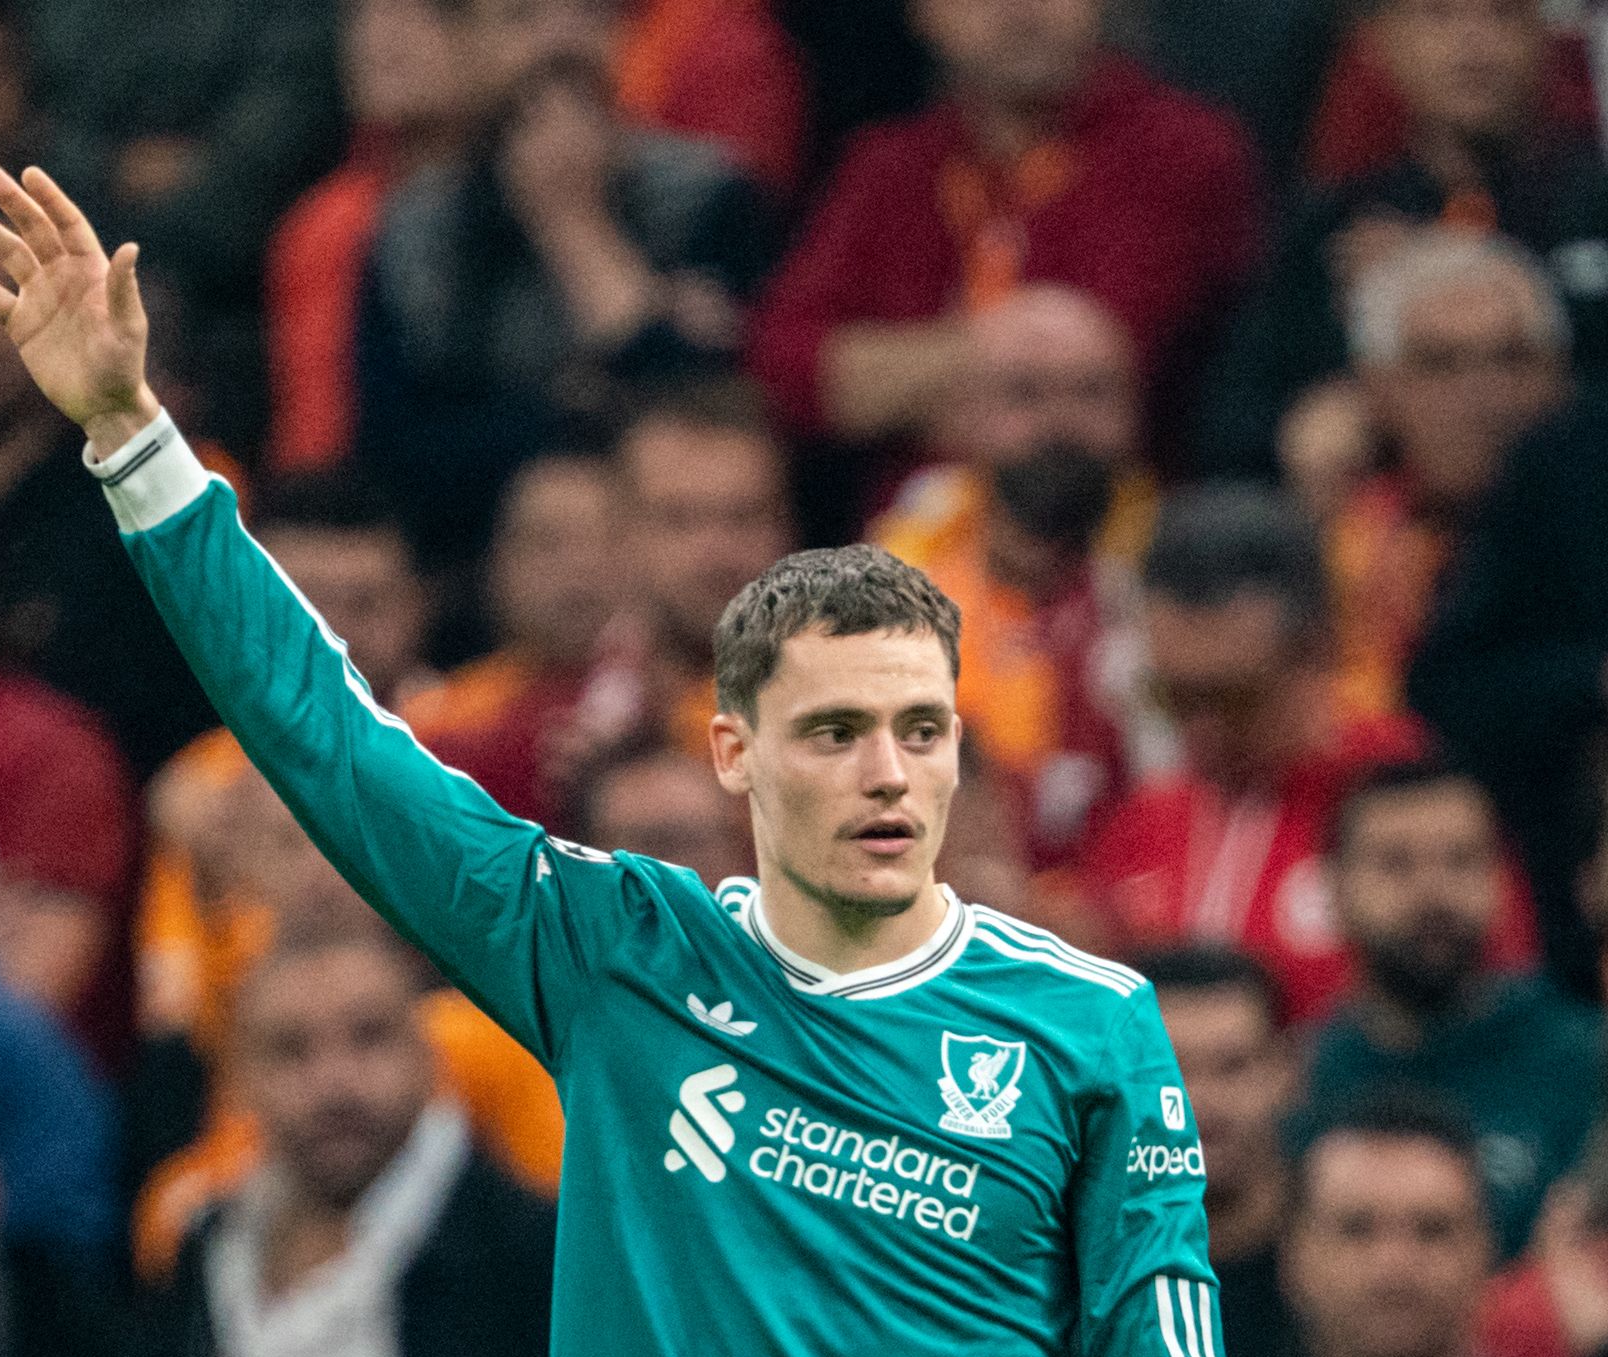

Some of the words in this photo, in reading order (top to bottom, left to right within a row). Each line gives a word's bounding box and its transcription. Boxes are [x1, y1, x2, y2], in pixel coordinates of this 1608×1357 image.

[758, 1106, 980, 1198] standard
[946, 1090, 974, 1121] LIVER
[981, 1098, 1010, 1123] POOL
[749, 1144, 980, 1241] chartered
